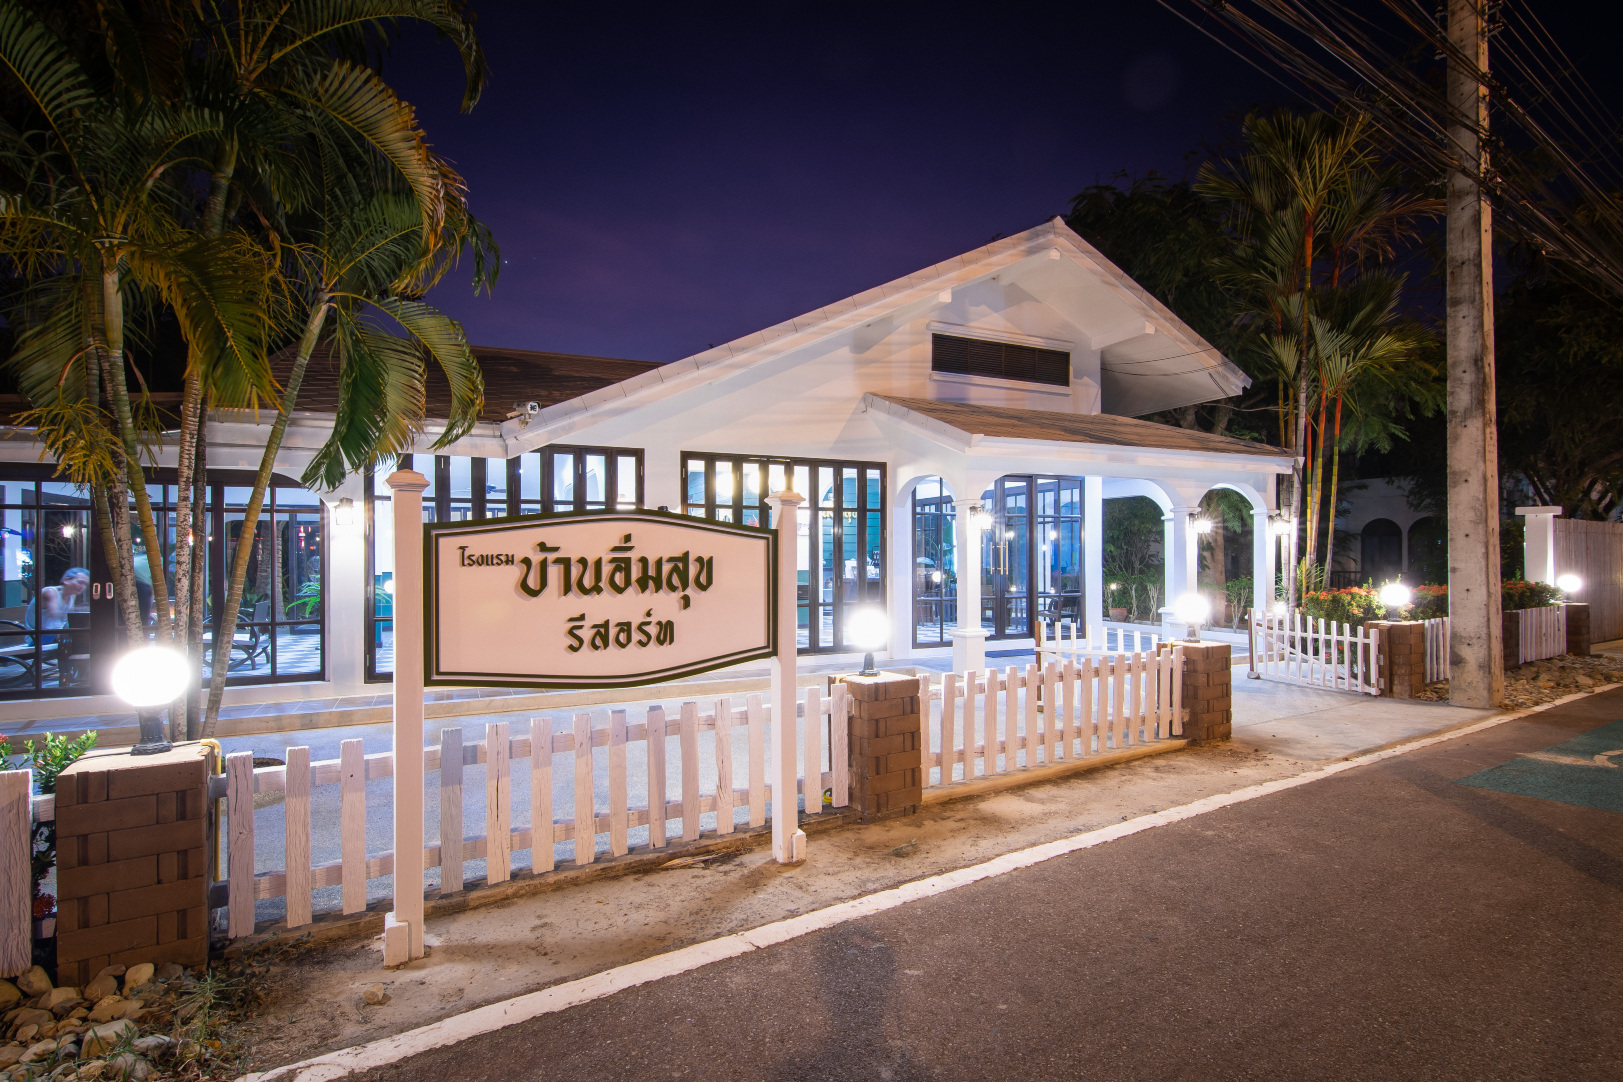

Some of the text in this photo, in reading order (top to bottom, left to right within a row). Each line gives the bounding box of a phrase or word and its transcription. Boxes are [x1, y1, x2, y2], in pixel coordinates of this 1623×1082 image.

[458, 533, 714, 610] โรงแรม บ้านอิ่มสุข
[566, 607, 675, 653] รีสอร์ท
